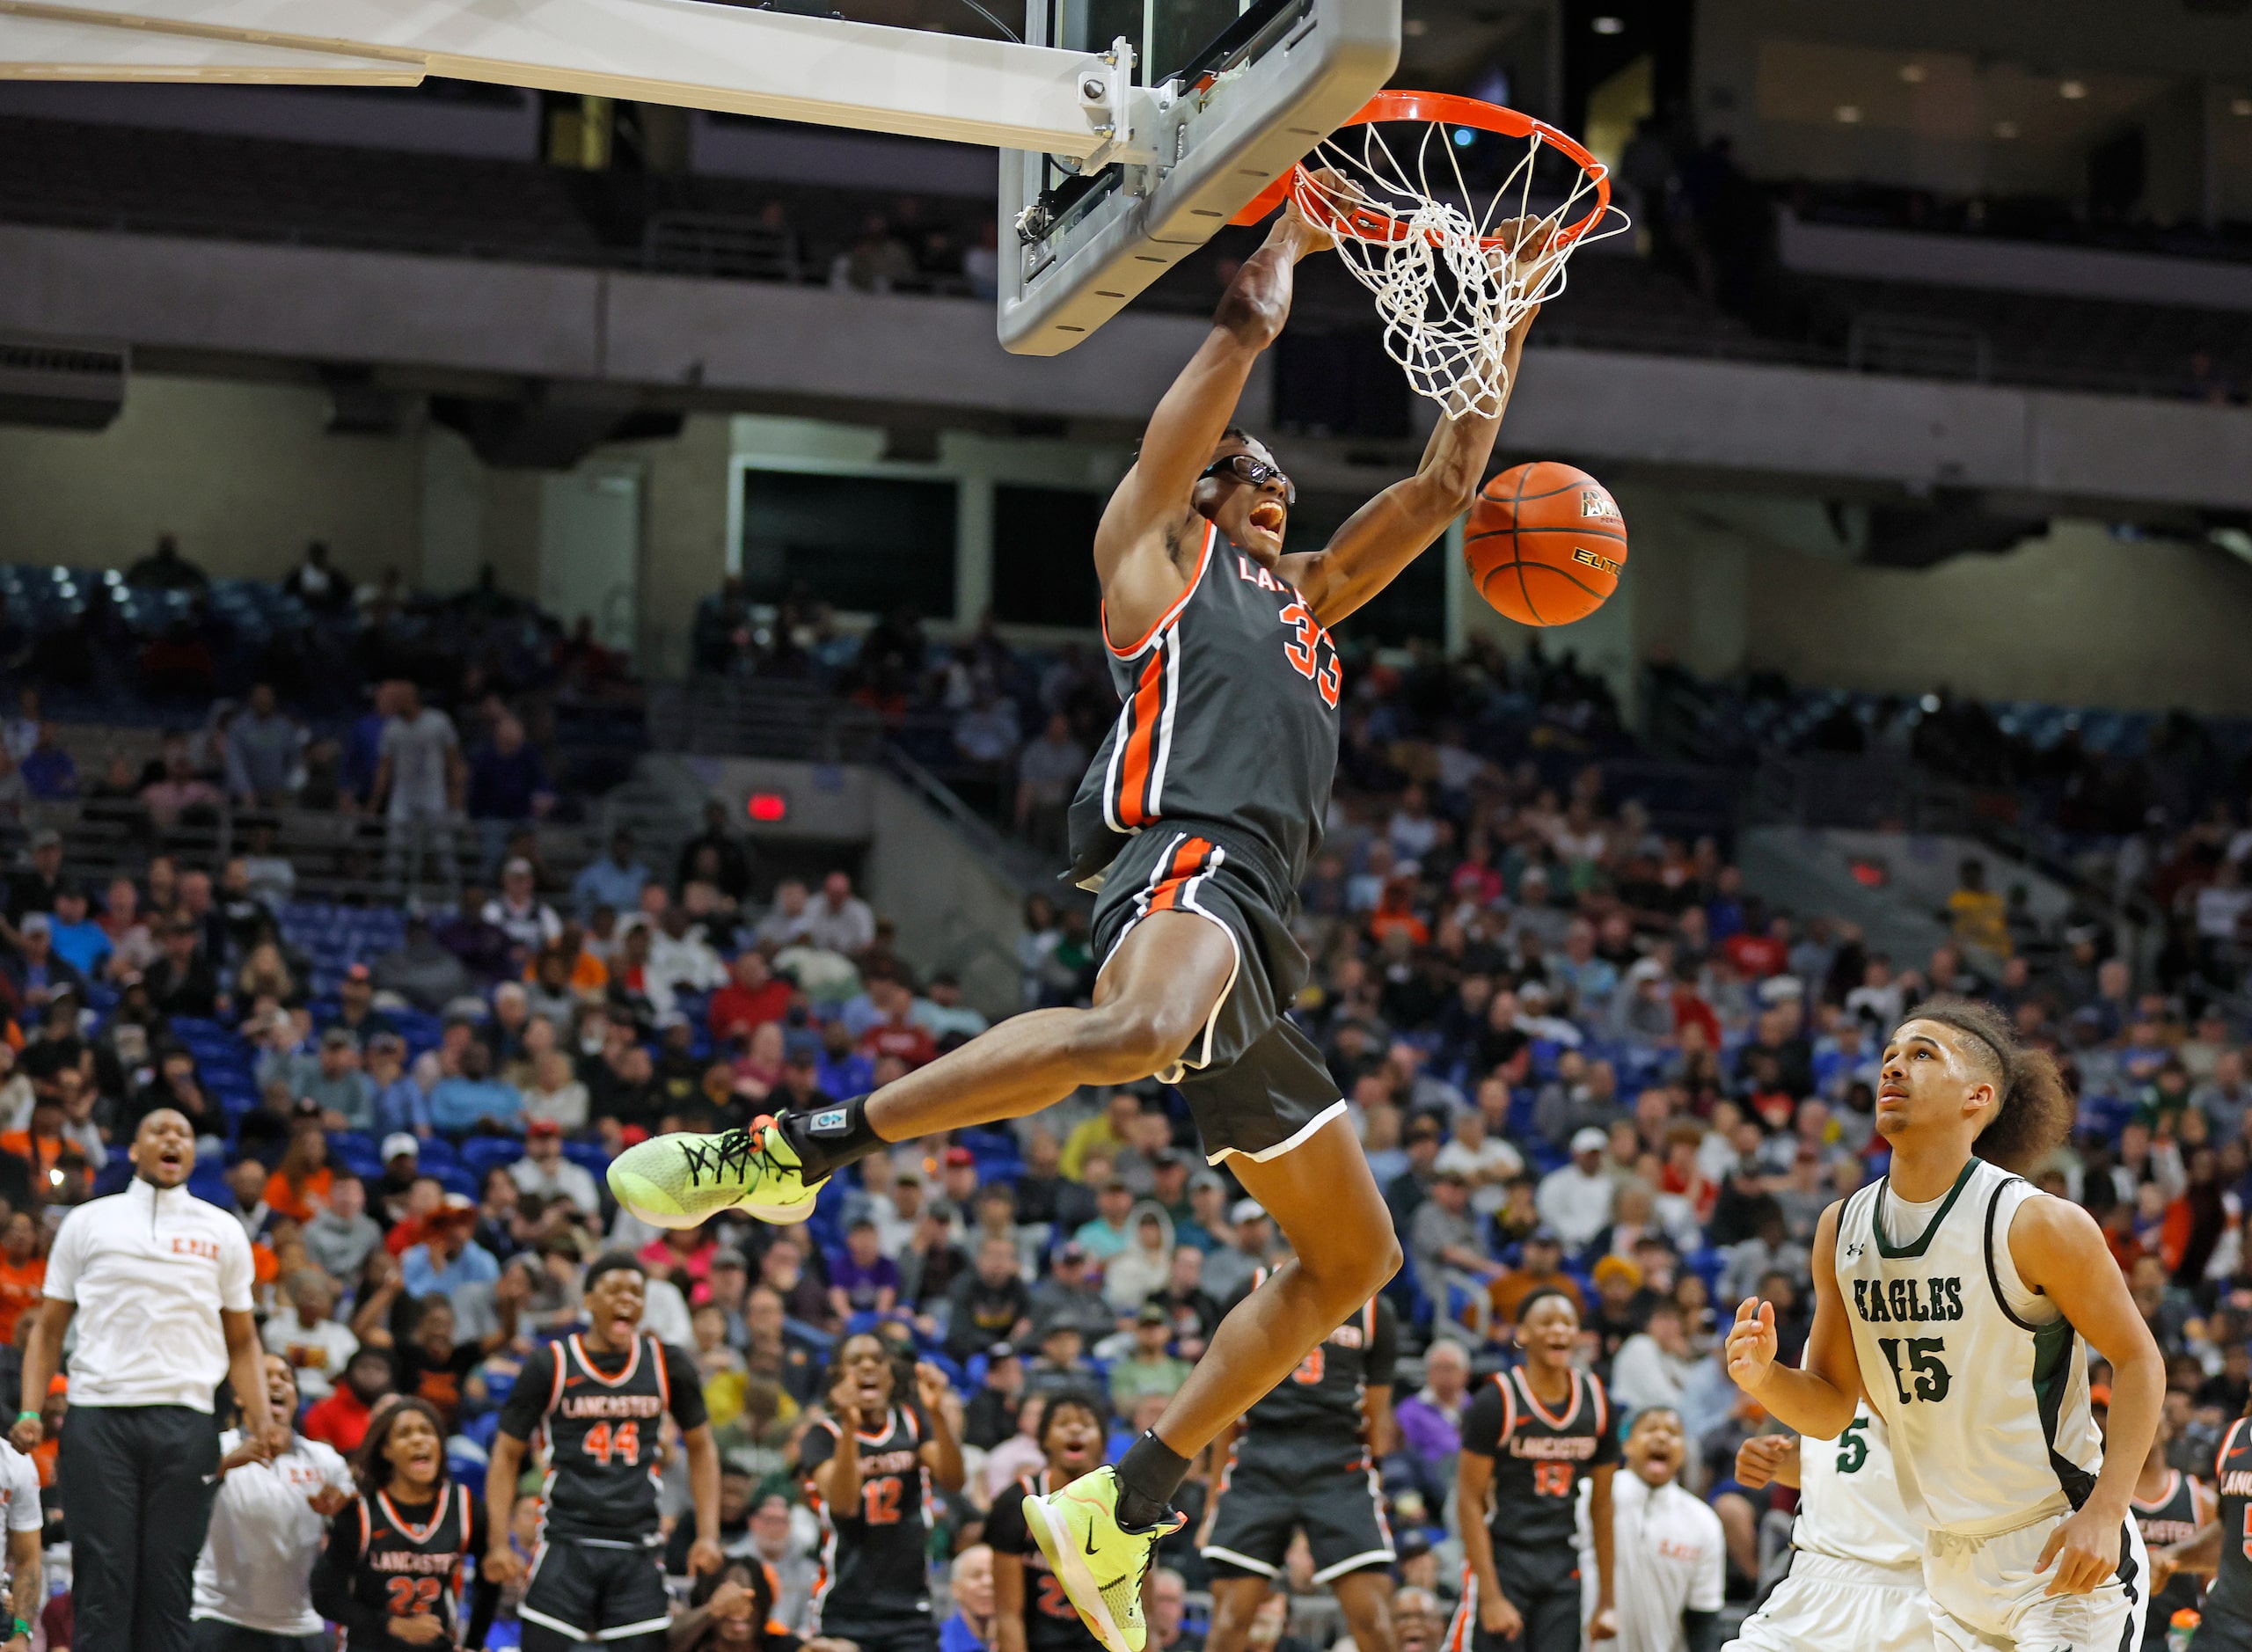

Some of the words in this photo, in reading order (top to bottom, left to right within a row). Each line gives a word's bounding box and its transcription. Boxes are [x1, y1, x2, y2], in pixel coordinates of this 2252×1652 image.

[1279, 603, 1342, 711] 33
[1853, 1276, 1964, 1322] EAGLES
[1877, 1336, 1954, 1405] 15
[581, 1420, 640, 1466] 44
[1836, 1416, 1871, 1473] 5
[861, 1476, 903, 1524] 12
[385, 1575, 442, 1617] 22
